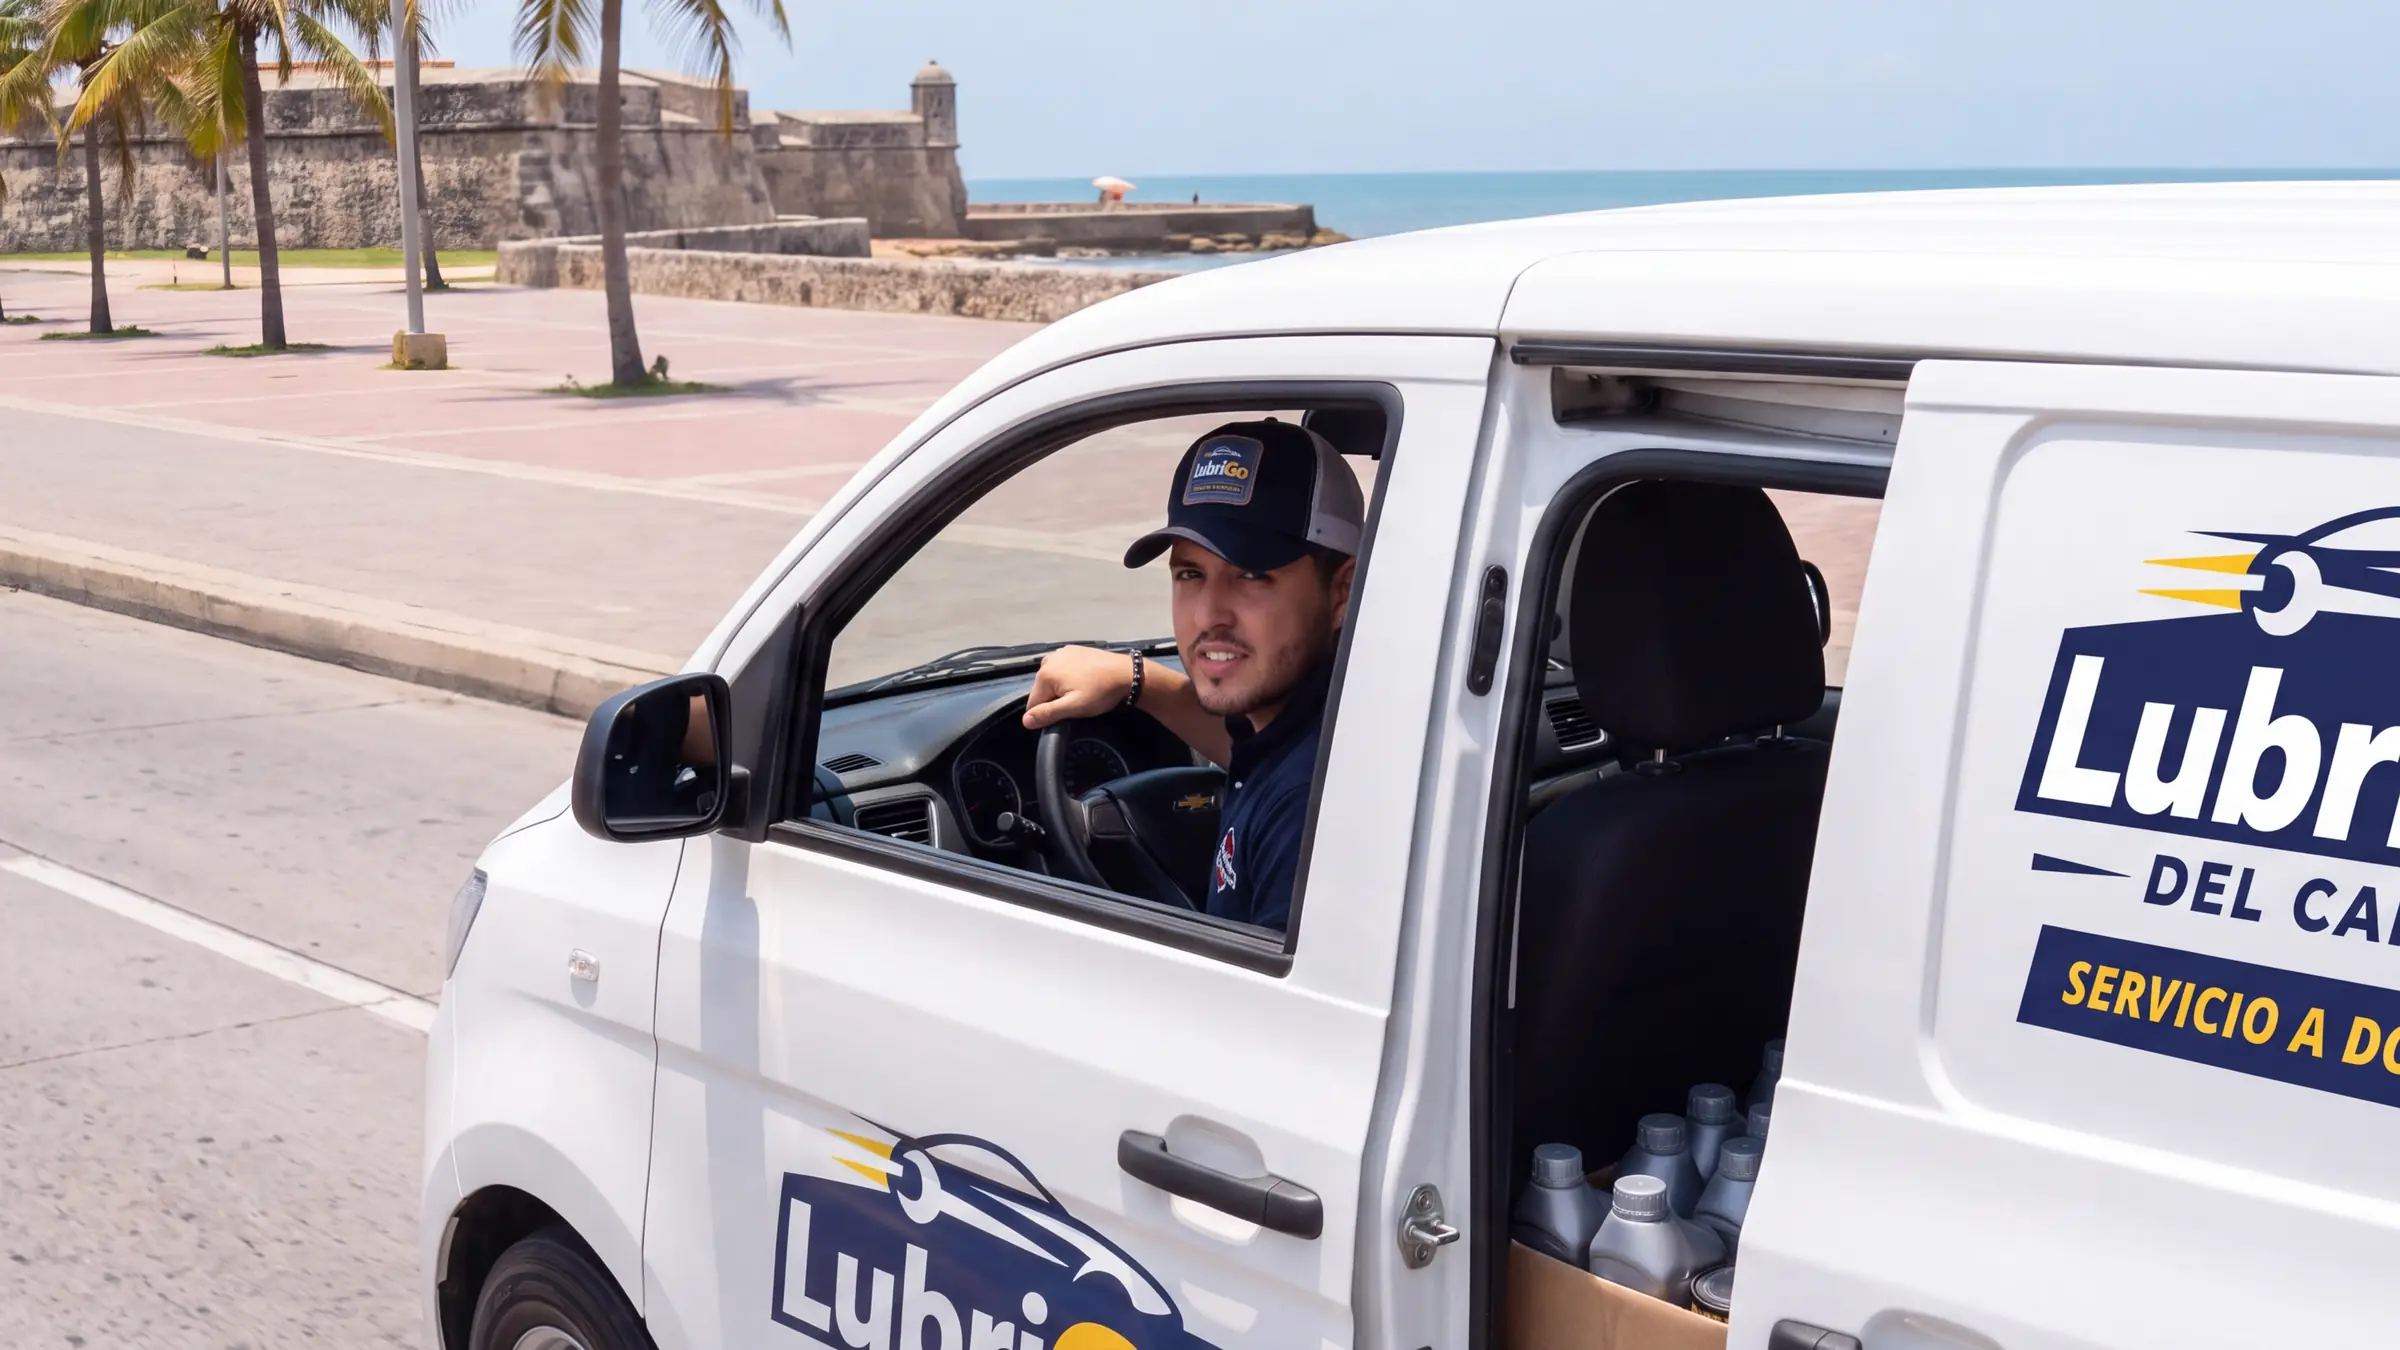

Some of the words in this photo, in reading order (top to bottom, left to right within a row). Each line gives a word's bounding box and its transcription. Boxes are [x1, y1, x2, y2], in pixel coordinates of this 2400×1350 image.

[2036, 654, 2400, 848] Lubr
[2143, 854, 2262, 922] DEL
[2062, 961, 2279, 1045] SERVICIO
[2287, 1007, 2325, 1058] A
